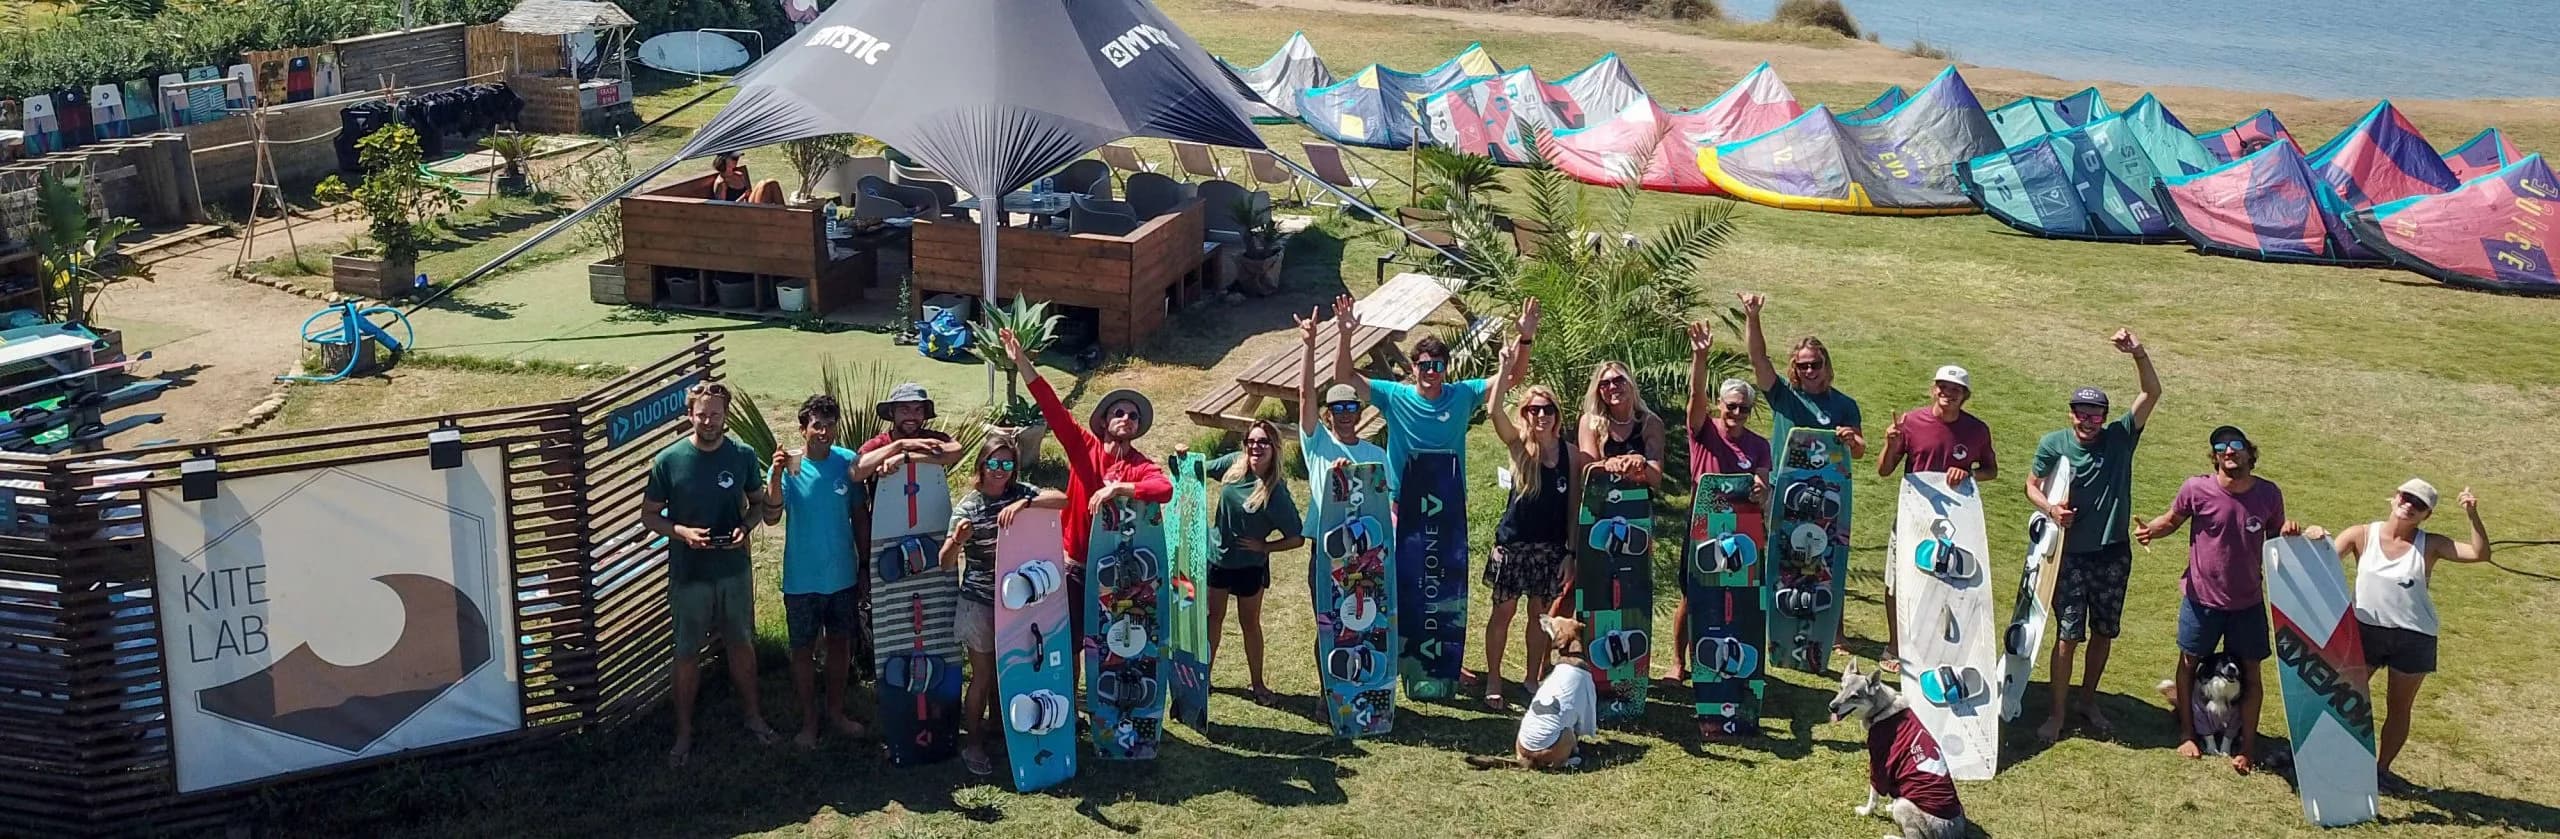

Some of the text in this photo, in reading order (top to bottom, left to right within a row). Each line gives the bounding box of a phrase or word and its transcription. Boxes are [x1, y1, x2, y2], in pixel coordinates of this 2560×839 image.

[1878, 151, 1910, 179] EVO
[1993, 174, 2013, 203] 12
[633, 389, 688, 432] DUOTON
[182, 564, 271, 613] KITE
[1424, 525, 1440, 630] DUOTONE
[188, 615, 269, 663] LAB
